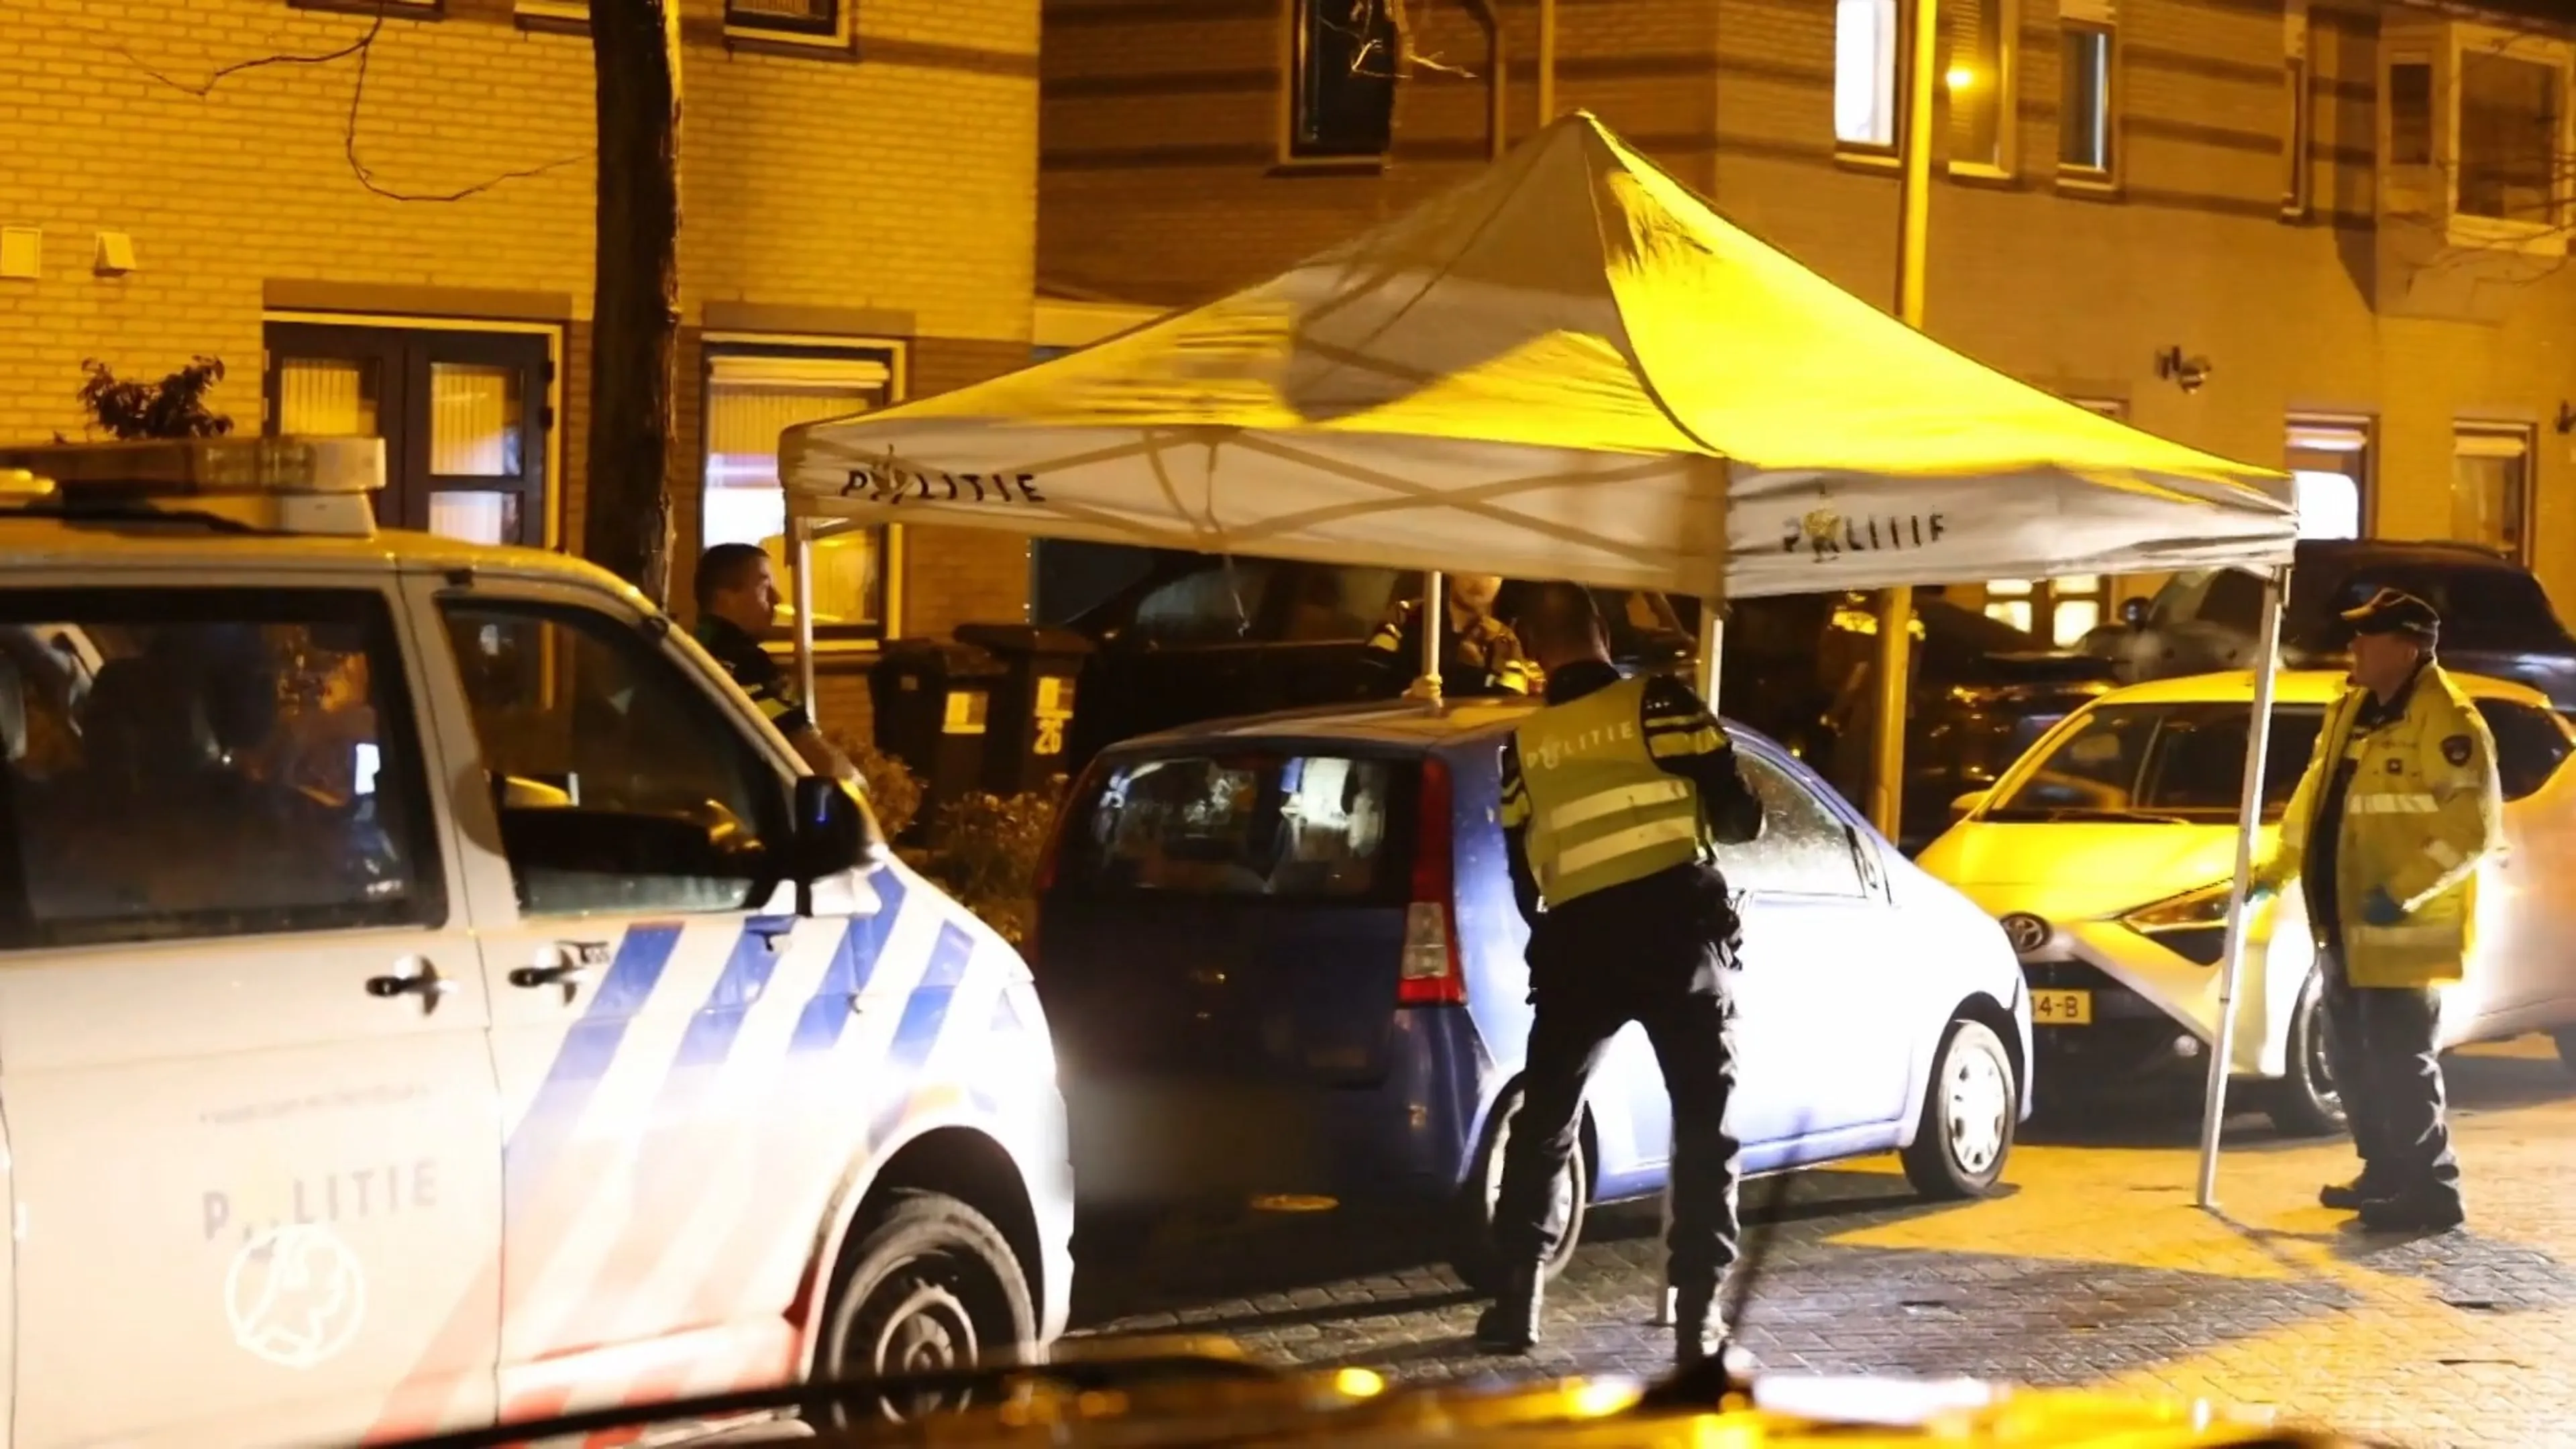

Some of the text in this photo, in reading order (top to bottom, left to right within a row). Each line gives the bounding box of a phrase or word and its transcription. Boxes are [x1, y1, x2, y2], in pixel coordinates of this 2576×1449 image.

[840, 458, 1046, 504] PLITIE
[1525, 720, 1634, 769] PLITIE
[203, 1159, 436, 1248] PLITIE
